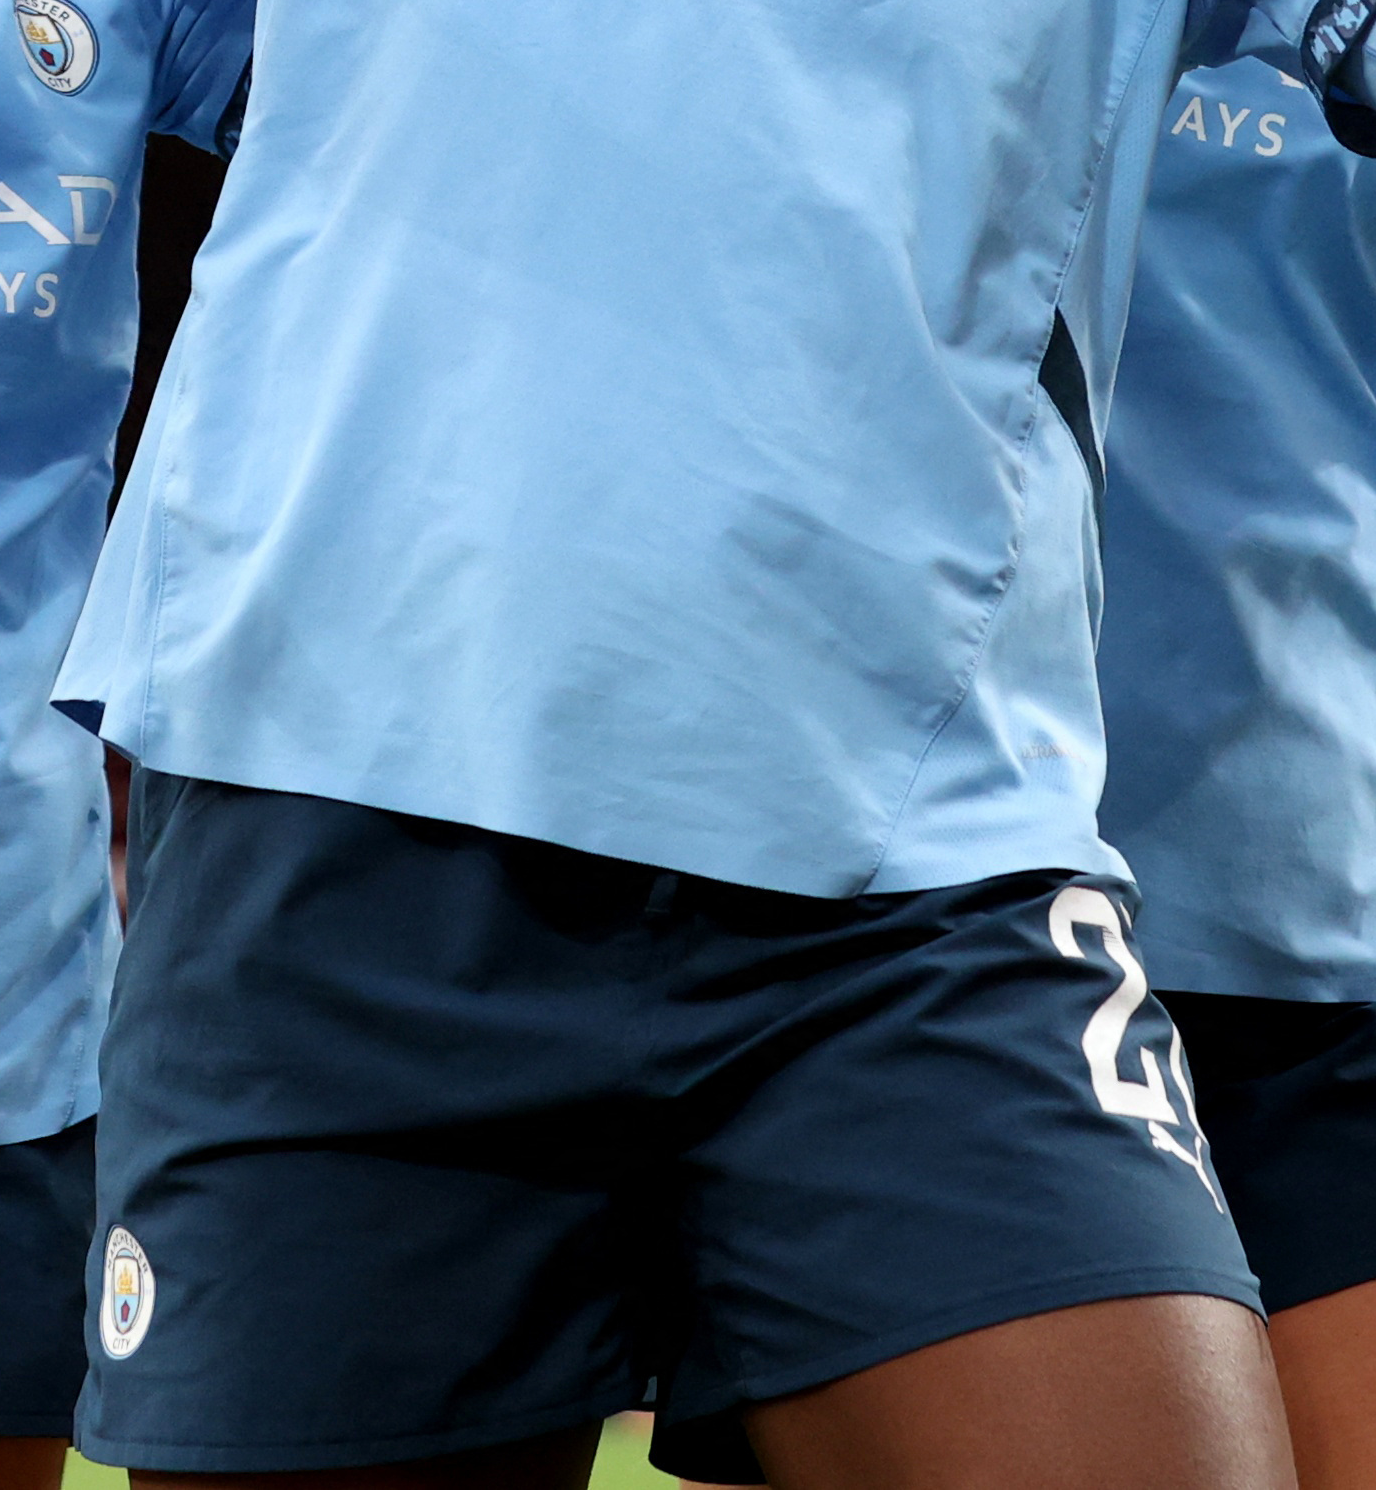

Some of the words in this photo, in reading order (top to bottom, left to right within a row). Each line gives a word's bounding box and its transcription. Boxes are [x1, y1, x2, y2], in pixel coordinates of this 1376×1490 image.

[47, 77, 72, 89] CITY
[107, 1233, 149, 1274] MANCHESTER
[112, 1338, 131, 1351] CITY
